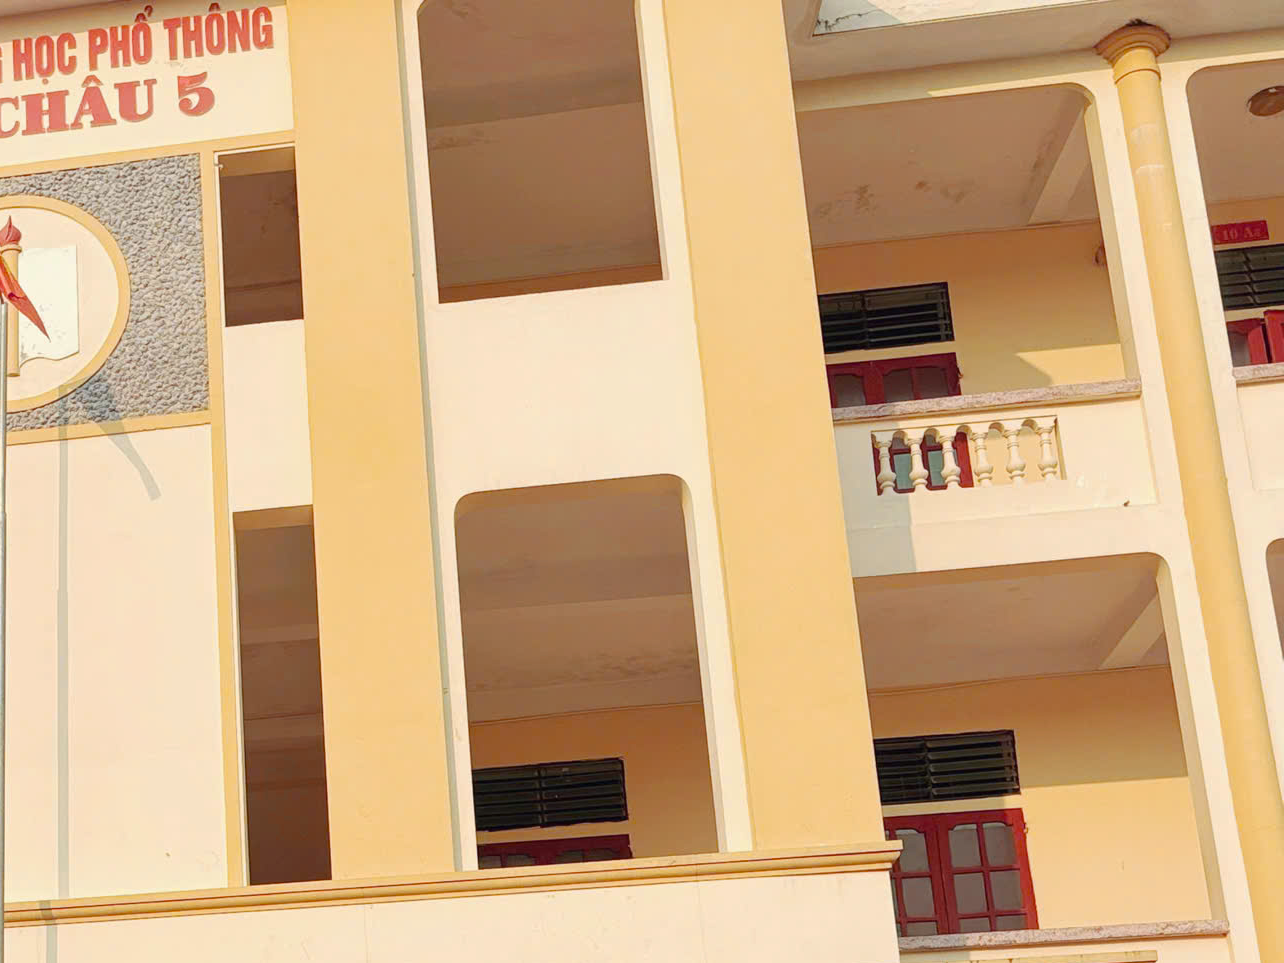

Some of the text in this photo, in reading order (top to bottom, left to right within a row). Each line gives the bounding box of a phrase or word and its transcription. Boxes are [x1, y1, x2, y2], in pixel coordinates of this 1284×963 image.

[13, 32, 77, 84] HỌC
[88, 5, 154, 71] PHỔ
[163, 3, 274, 60] THÔNG
[177, 72, 215, 117] 5
